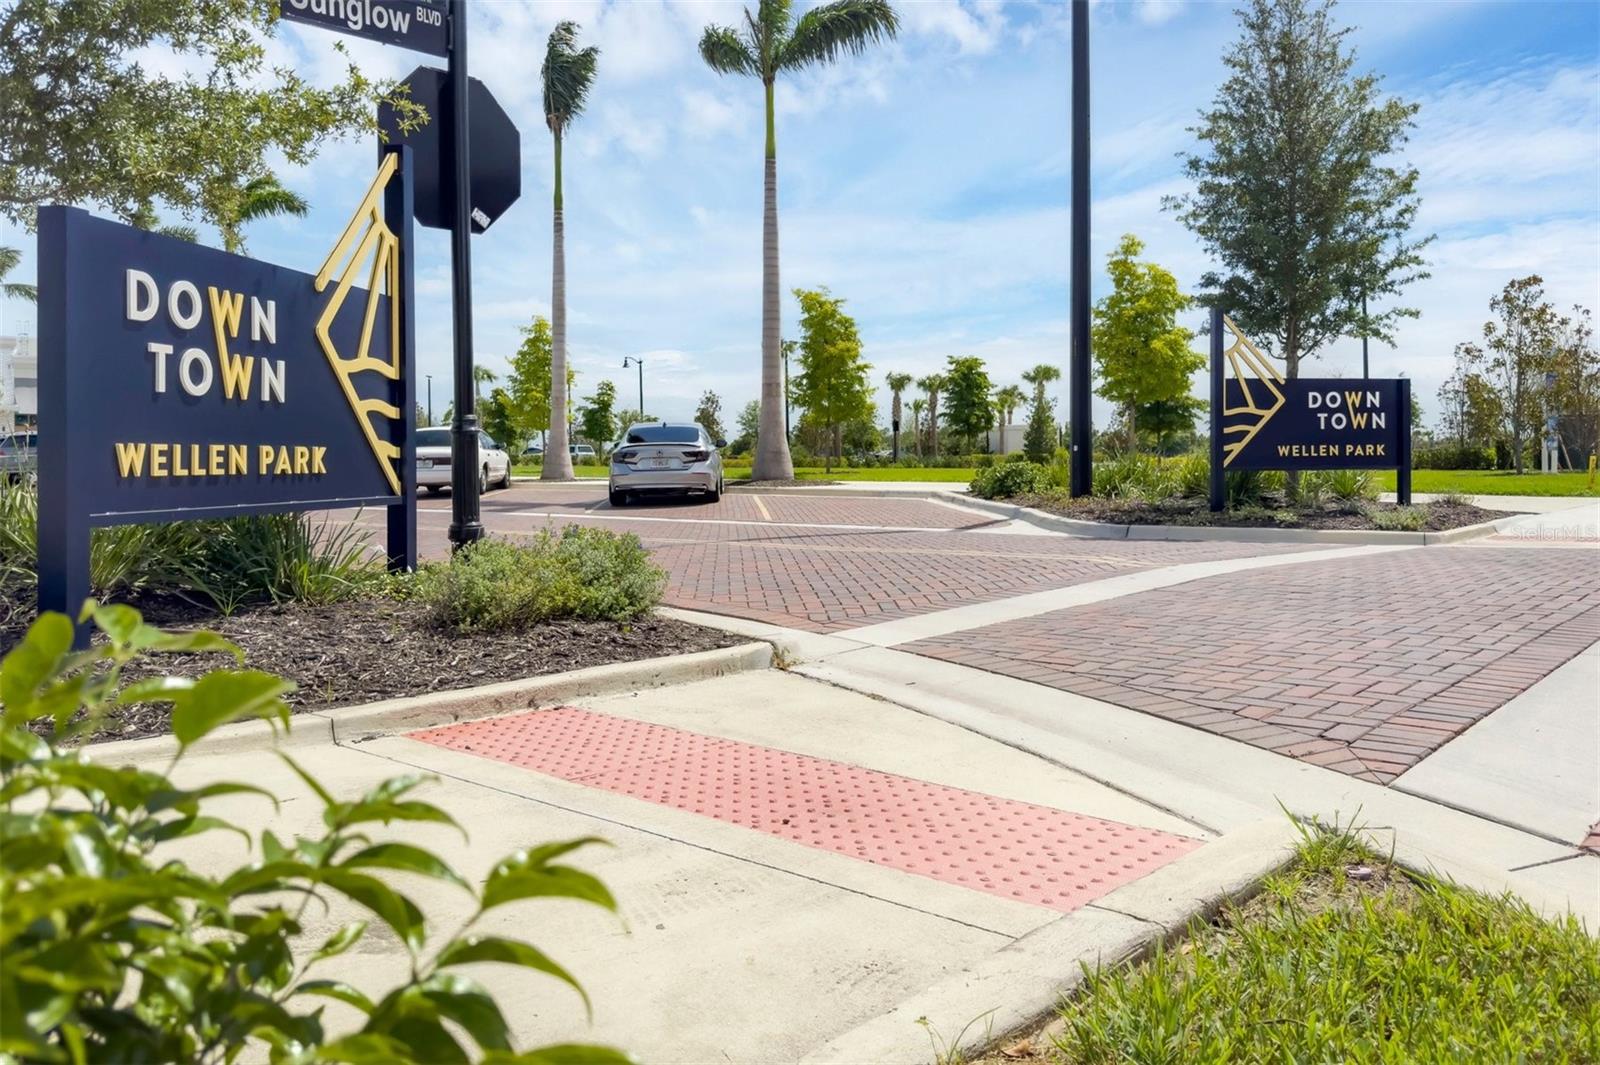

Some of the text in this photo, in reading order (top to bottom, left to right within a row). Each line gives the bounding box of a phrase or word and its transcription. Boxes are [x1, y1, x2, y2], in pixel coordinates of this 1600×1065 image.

[291, 0, 442, 34] unglow BLVD
[126, 269, 276, 344] DOWN
[148, 342, 286, 403] TOWN
[1308, 391, 1380, 409] DOWN
[1317, 412, 1386, 430] TOWN
[115, 442, 327, 478] WELLEN PARK
[1277, 444, 1386, 457] WELLEN PARK
